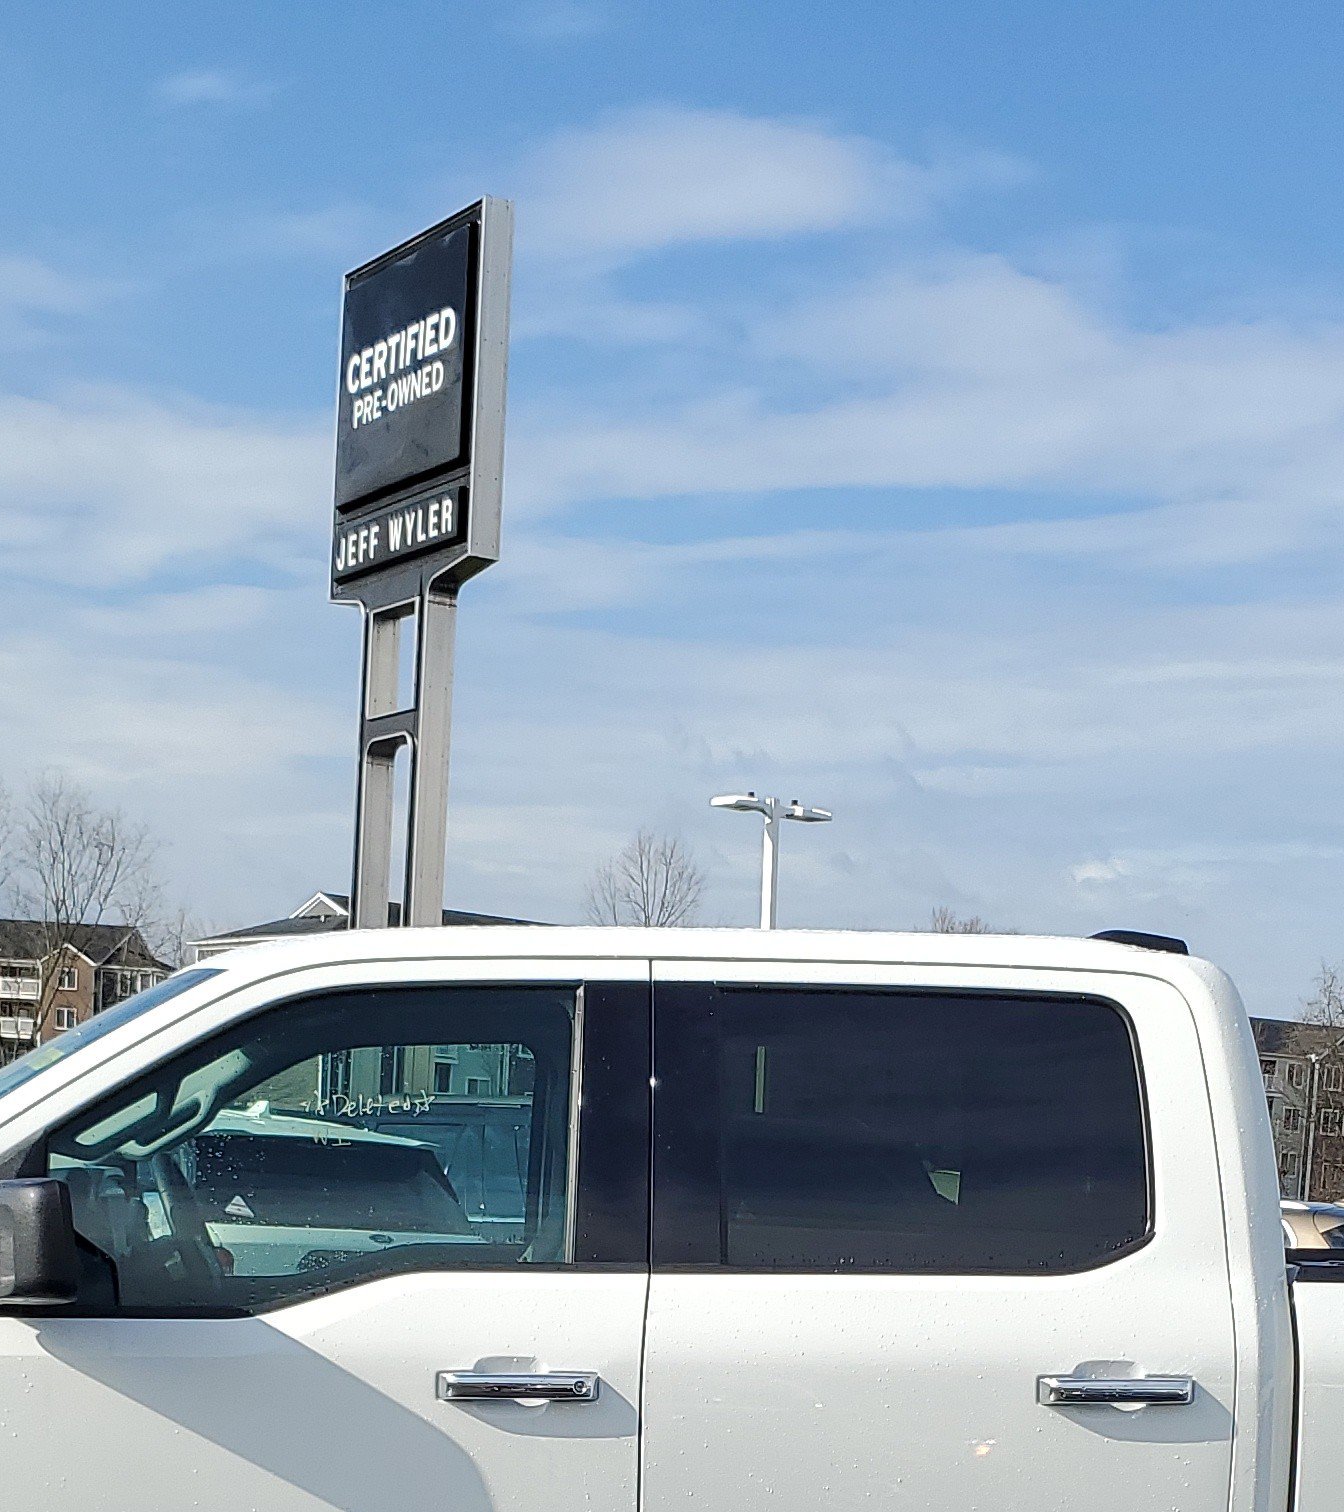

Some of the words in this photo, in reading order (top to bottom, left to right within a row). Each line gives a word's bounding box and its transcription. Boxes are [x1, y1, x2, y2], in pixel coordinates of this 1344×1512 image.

[346, 307, 456, 394] CERTIFIED
[352, 361, 444, 429] PRE-OWNED
[336, 524, 380, 571] JEFF
[387, 498, 453, 552] WYLER
